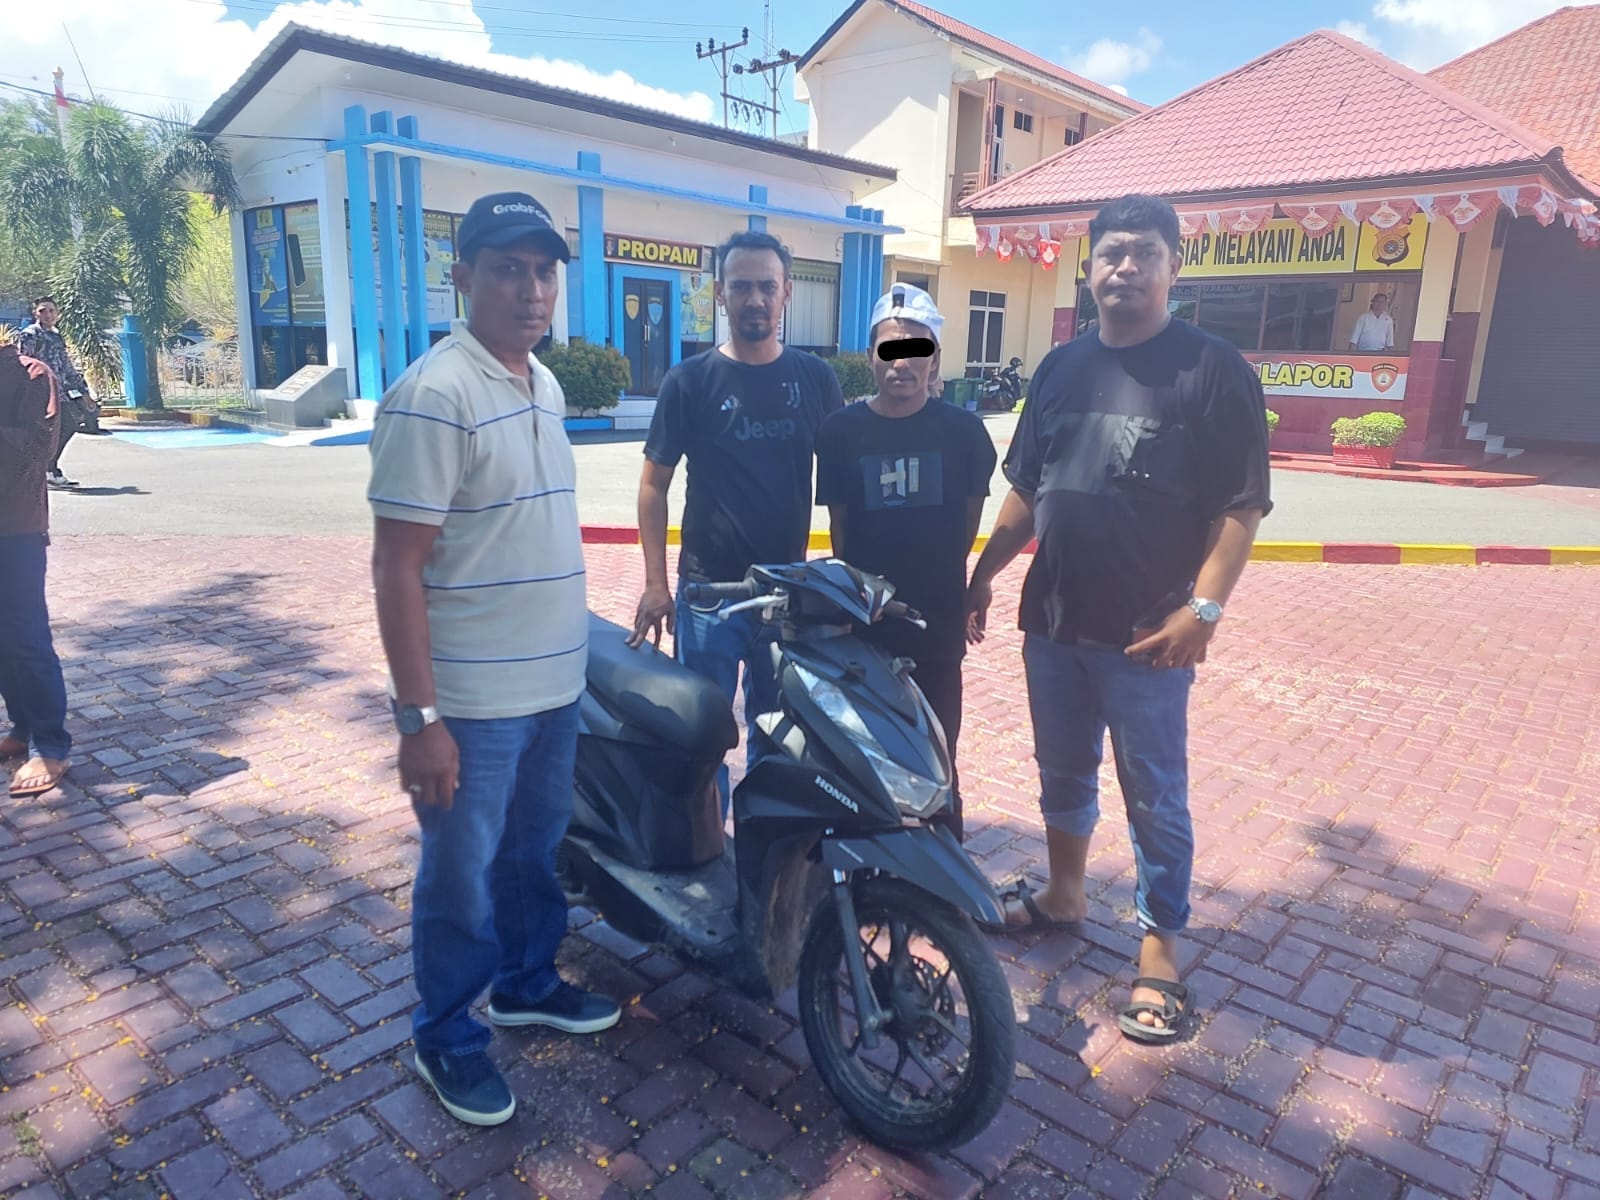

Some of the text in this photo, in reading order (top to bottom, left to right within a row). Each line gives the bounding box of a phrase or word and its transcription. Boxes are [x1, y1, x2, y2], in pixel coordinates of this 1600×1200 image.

[618, 238, 697, 265] PROPAM
[1214, 229, 1295, 266] MELAYANI
[1298, 226, 1344, 262] ANDA
[1260, 362, 1353, 388] LAPOR
[735, 417, 796, 440] Jeep
[880, 458, 919, 497] HI
[815, 774, 859, 813] HONDA
